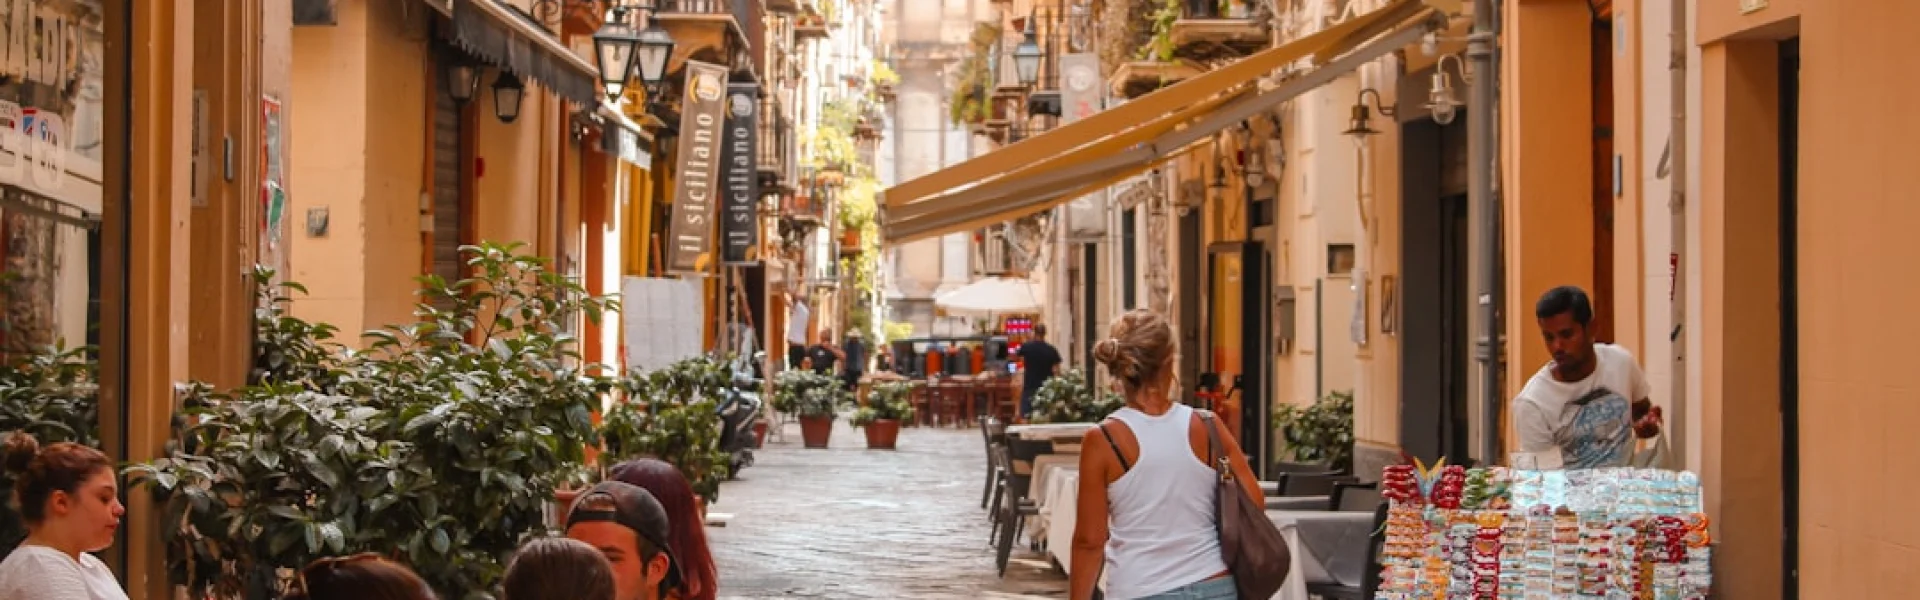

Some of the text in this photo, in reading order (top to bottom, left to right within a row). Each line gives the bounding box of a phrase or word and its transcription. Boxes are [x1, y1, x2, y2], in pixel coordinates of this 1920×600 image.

[678, 113, 713, 252] il siciliano
[728, 127, 749, 246] il siciliano
